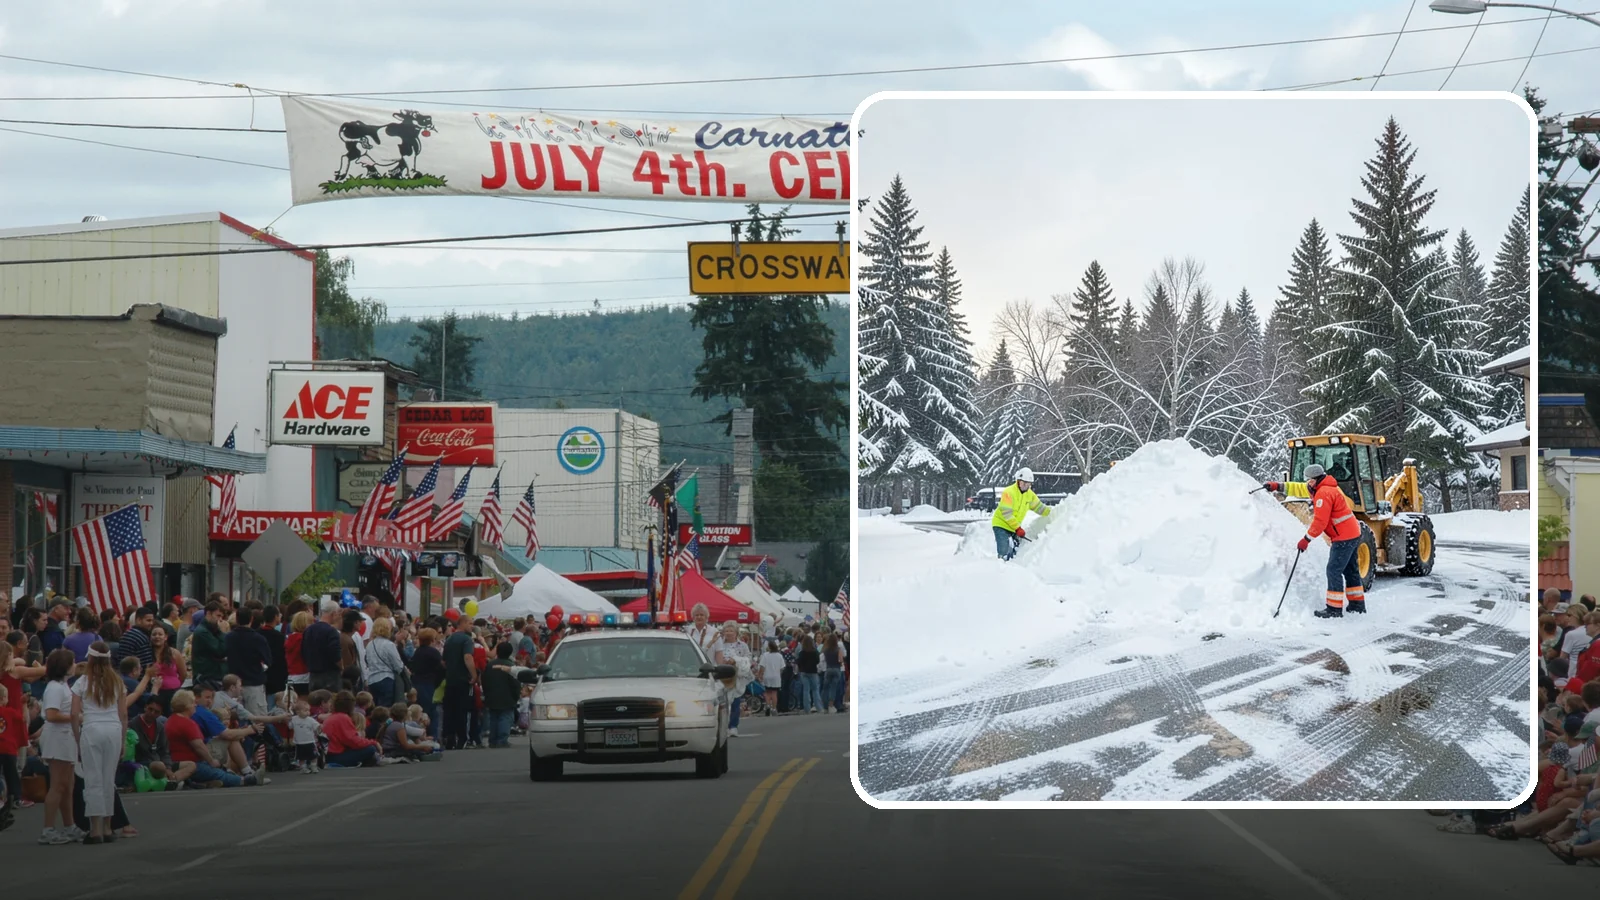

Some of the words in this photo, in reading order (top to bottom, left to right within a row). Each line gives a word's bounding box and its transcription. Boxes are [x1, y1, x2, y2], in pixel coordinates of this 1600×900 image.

[481, 141, 605, 191] JULY
[632, 150, 746, 198] 4th.
[697, 254, 850, 280] CROSSWA
[282, 380, 374, 420] ACE
[406, 409, 452, 422] CEDAR
[283, 421, 371, 436] Hardware
[417, 428, 477, 447] Coca-Cola
[83, 485, 94, 494] St.
[96, 485, 125, 495] Vincent
[126, 486, 136, 494] de
[137, 486, 155, 495] Paul
[212, 516, 331, 535] HARDARE
[688, 526, 741, 535] CRNATION
